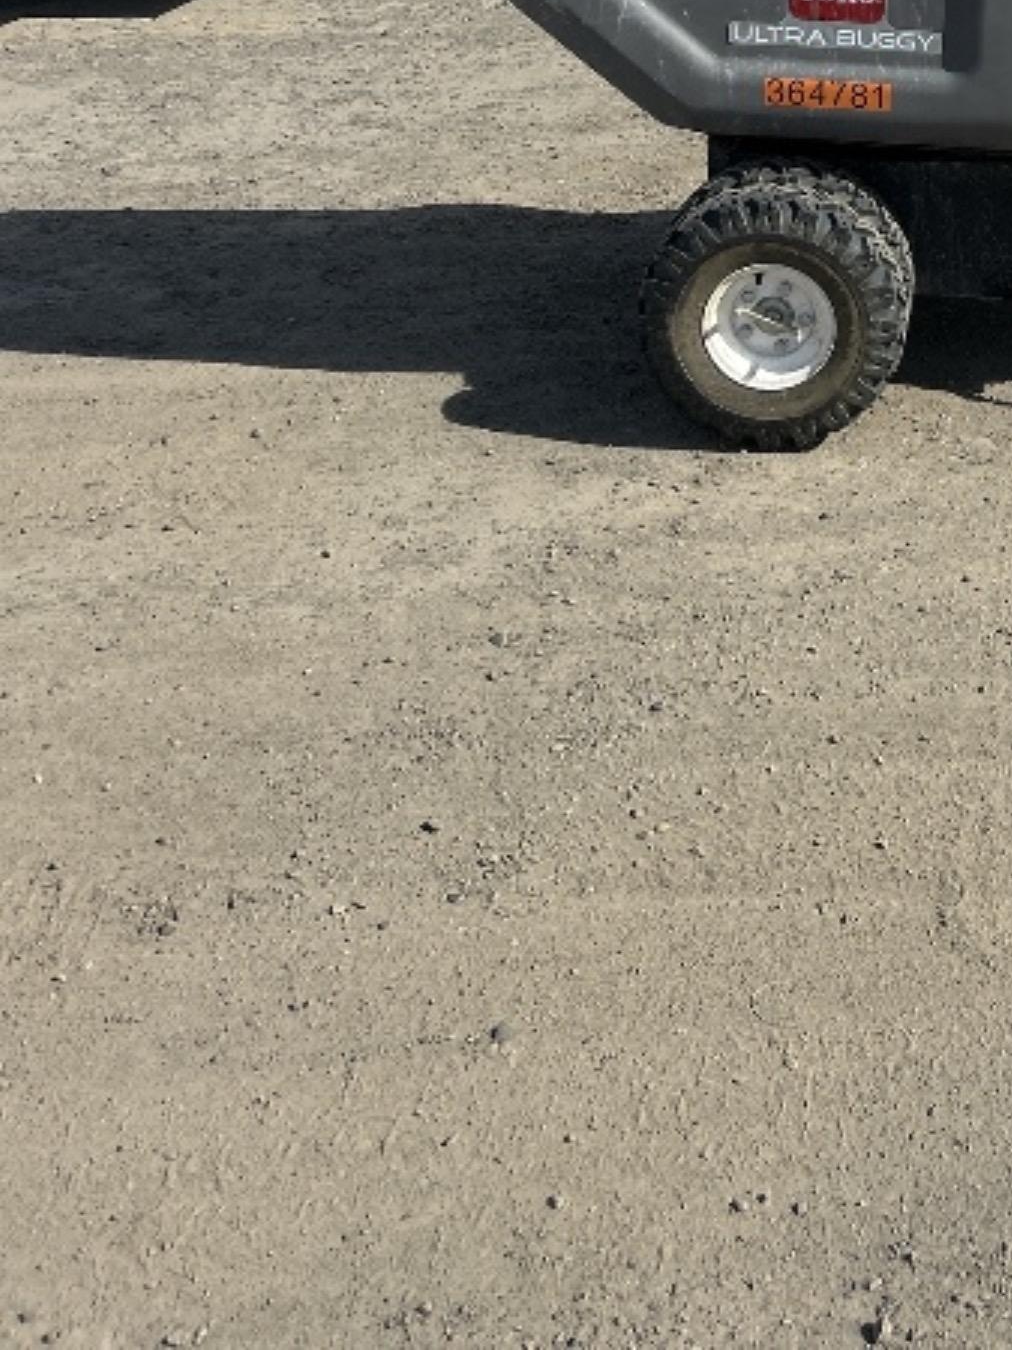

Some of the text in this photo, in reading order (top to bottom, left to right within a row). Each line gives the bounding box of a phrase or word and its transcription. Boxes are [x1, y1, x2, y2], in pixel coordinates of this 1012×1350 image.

[734, 23, 935, 52] ULTRA BUGGY
[766, 77, 885, 109] 364781
